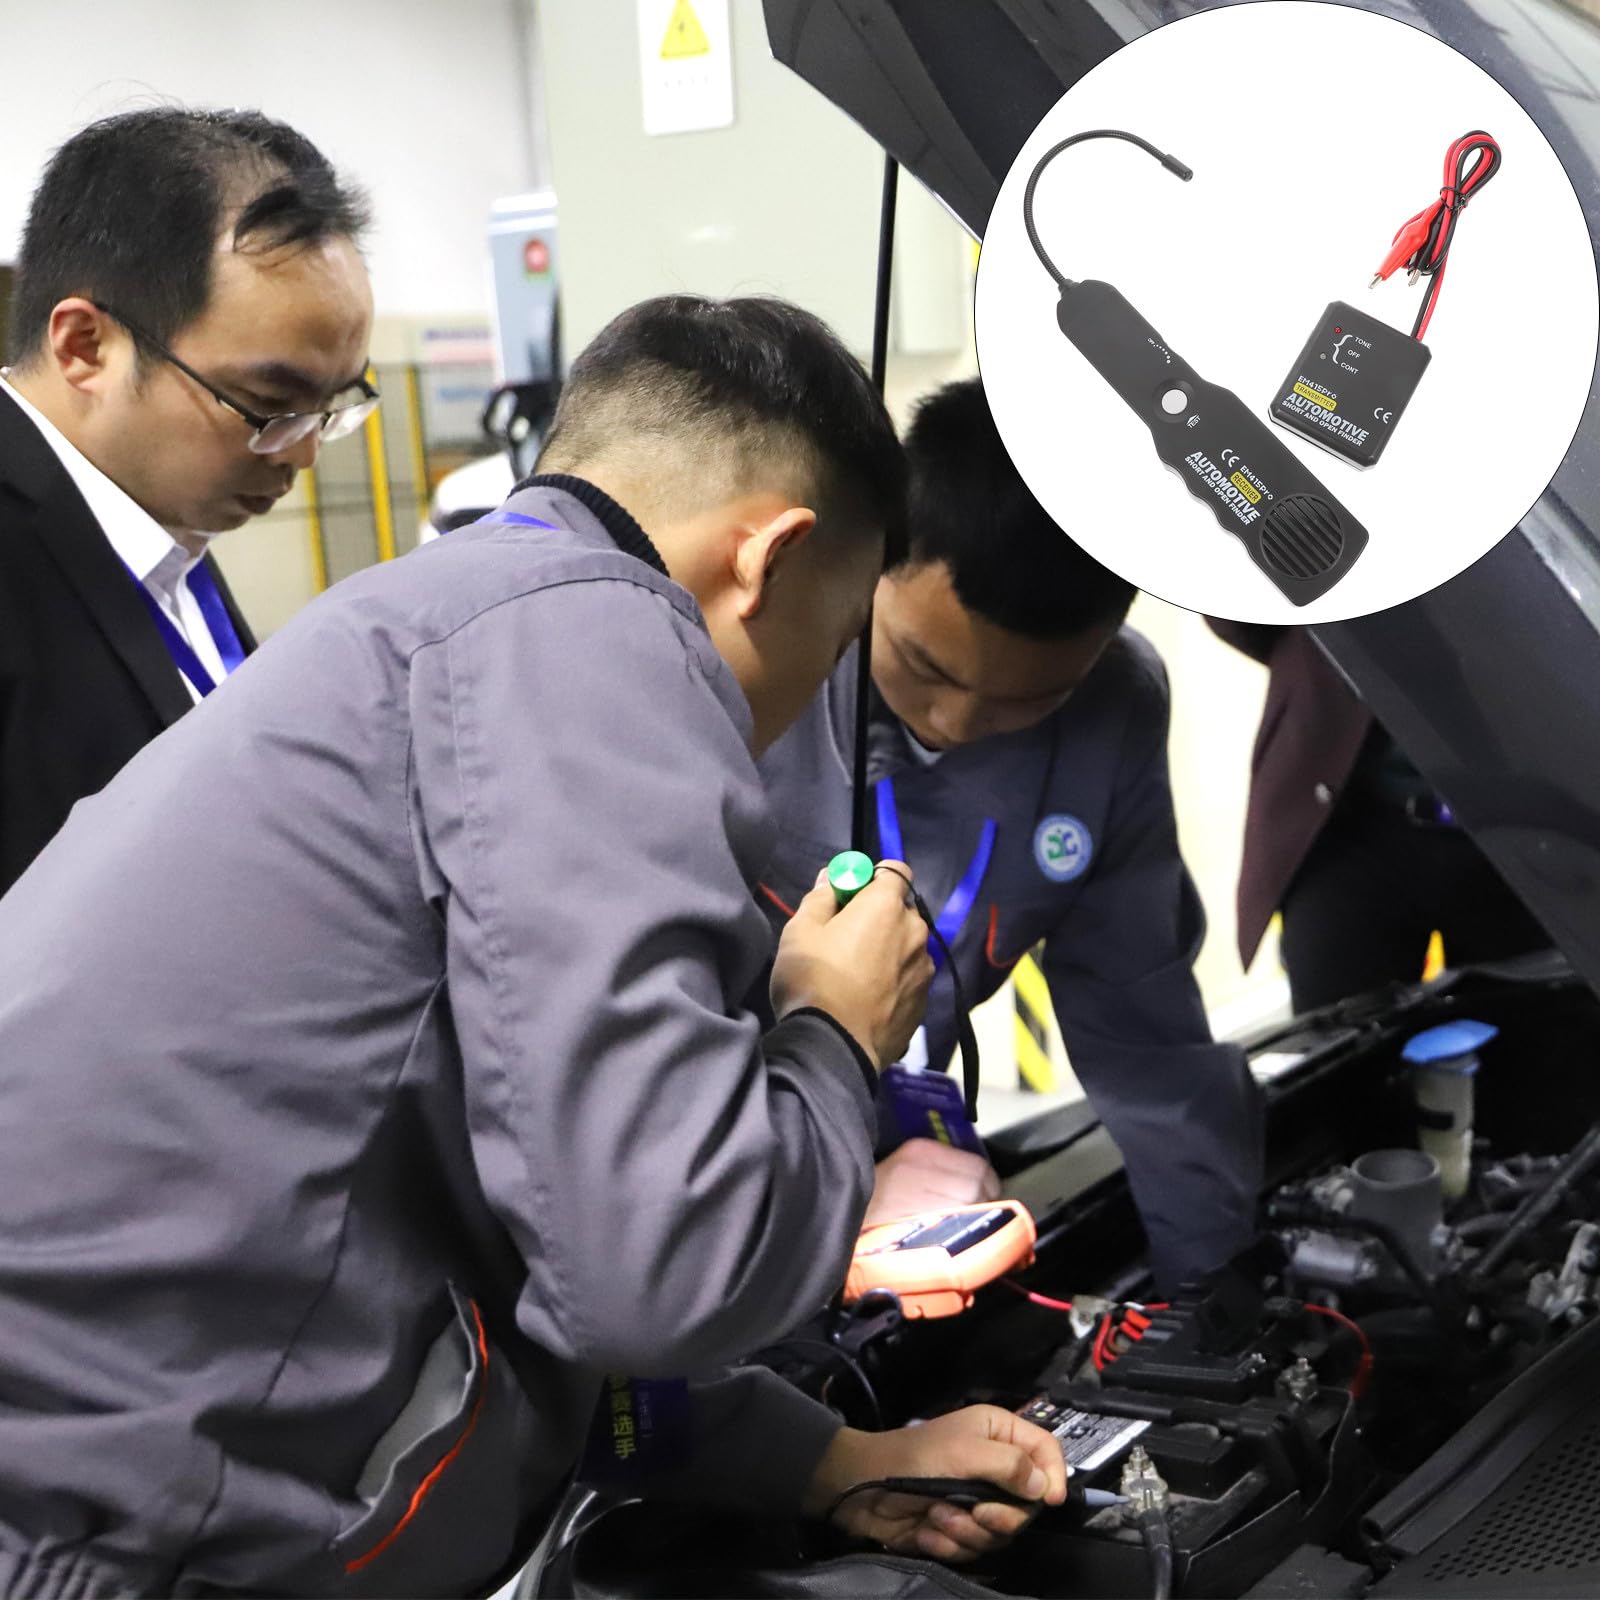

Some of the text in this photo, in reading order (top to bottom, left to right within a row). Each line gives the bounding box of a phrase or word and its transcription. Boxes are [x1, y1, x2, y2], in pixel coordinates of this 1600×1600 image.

[1347, 349, 1361, 359] OFF
[1354, 336, 1372, 349] TONE
[1340, 362, 1359, 374] CONT
[1295, 384, 1335, 409] TRANSMITTER
[1297, 375, 1337, 399] EM415Pro
[1282, 399, 1363, 447] SHORT AND OPEN FINDER
[1286, 393, 1370, 441] AUTOMOTIVE
[1373, 407, 1393, 424] CE
[1221, 448, 1240, 468] CE
[1184, 456, 1251, 526] SHORT AND OPEN FINDER
[1190, 451, 1261, 522] AUTOMOTIVE
[1231, 474, 1260, 502] RECEIVER
[1239, 465, 1274, 500] EM415Pro
